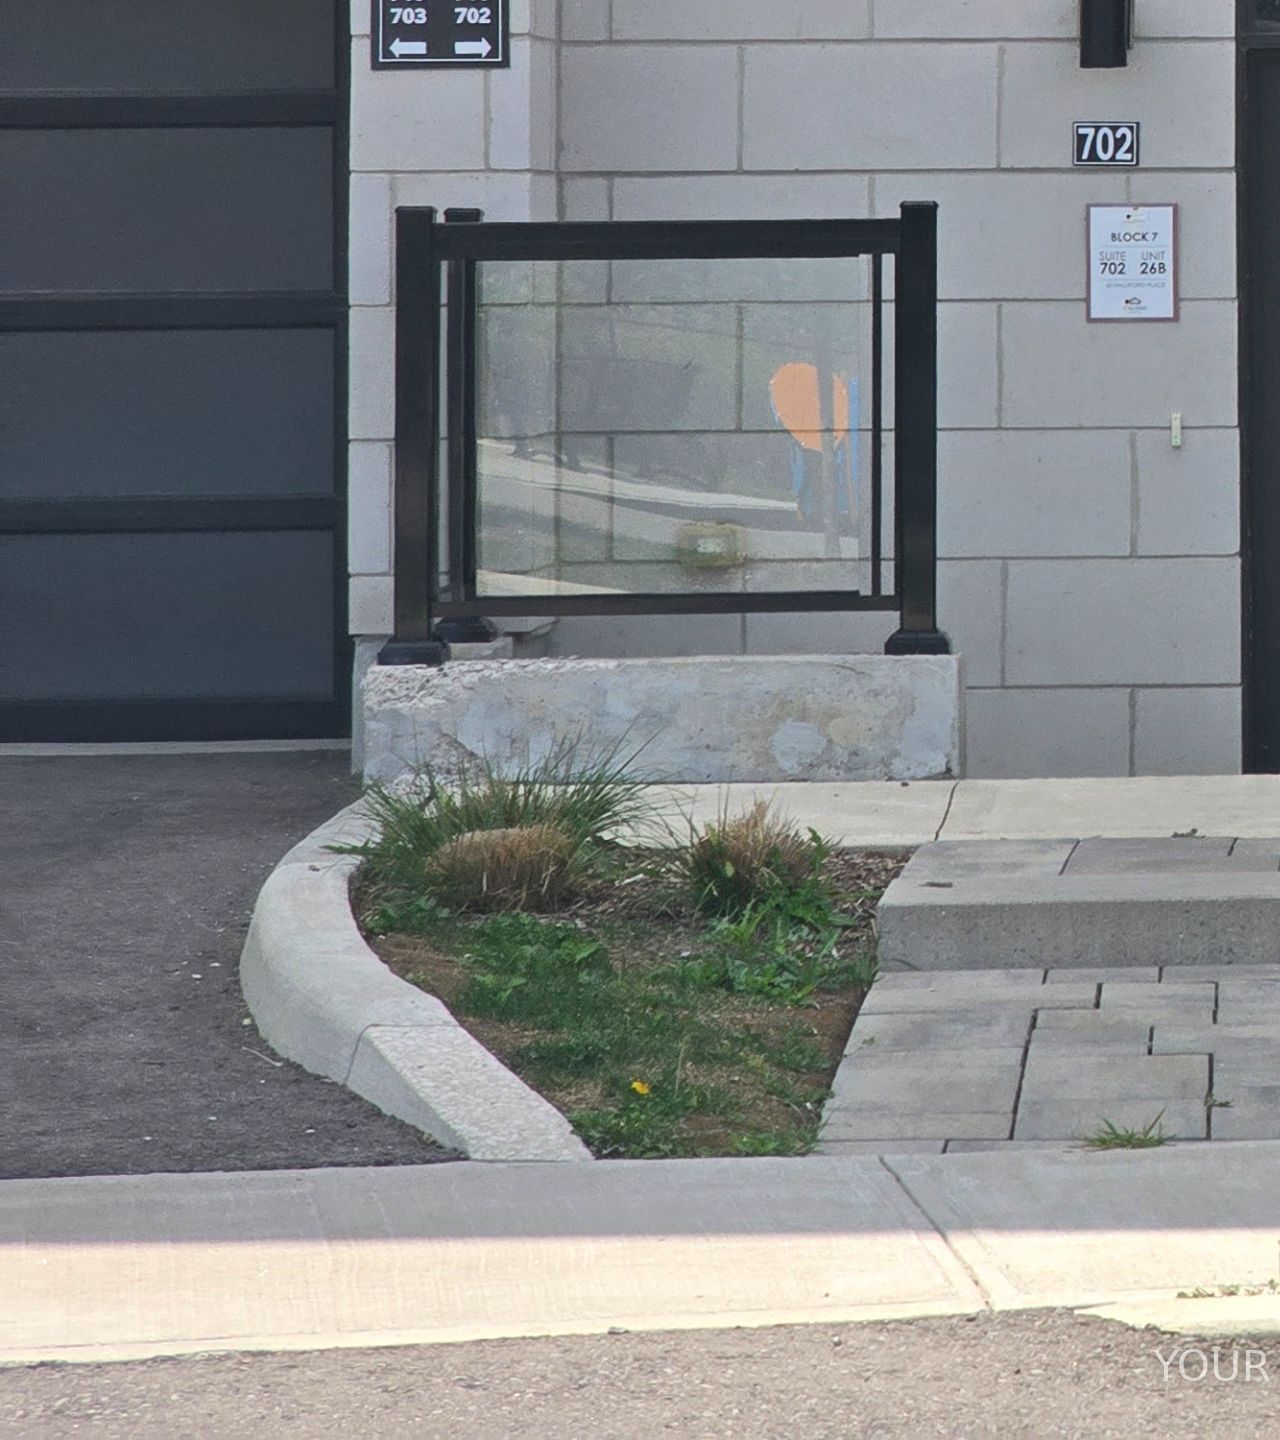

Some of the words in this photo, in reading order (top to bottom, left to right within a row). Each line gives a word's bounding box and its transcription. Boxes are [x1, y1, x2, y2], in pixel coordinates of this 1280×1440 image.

[390, 8, 428, 24] 703
[454, 8, 491, 24] 702
[1077, 126, 1133, 161] 702
[1110, 232, 1149, 242] BLOCK
[1151, 232, 1158, 242] 7
[1098, 250, 1127, 261] SUITE
[1140, 250, 1165, 261] UNIT
[1099, 262, 1126, 275] 702
[1140, 262, 1167, 275] 26B
